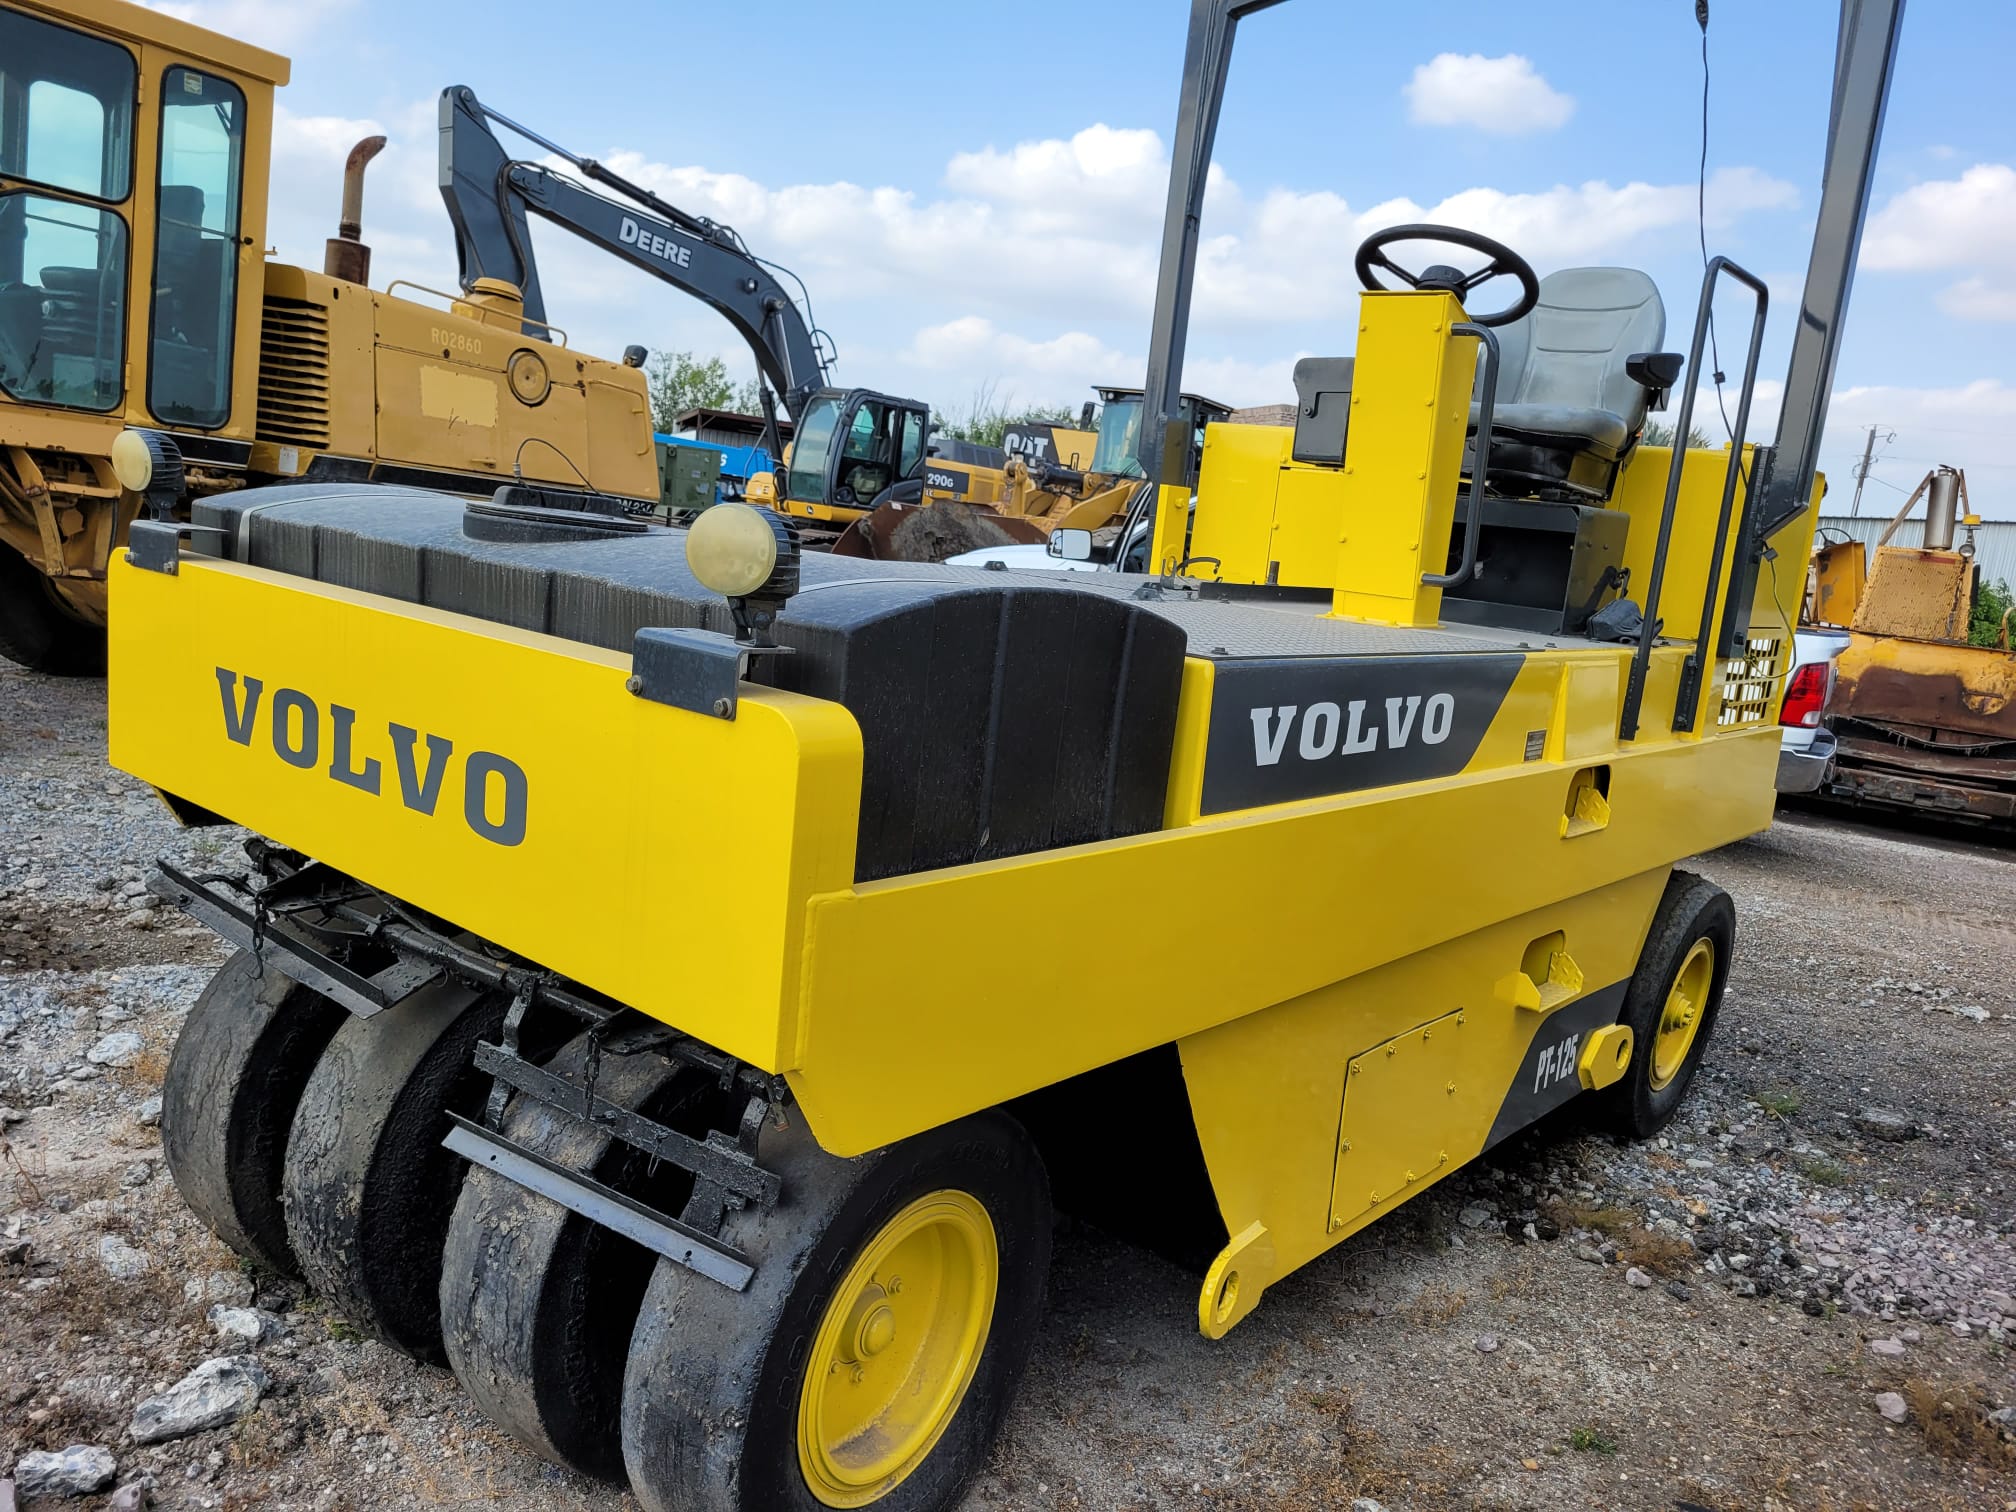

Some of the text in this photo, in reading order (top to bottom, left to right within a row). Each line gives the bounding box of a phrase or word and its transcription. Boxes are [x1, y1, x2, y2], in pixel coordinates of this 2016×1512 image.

[619, 217, 692, 268] DEERE
[1003, 433, 1049, 458] CAT
[927, 473, 954, 487] 290G
[215, 666, 528, 847] VOLVO
[1250, 692, 1455, 767] VOLVO
[1533, 1033, 1579, 1095] PT-125
